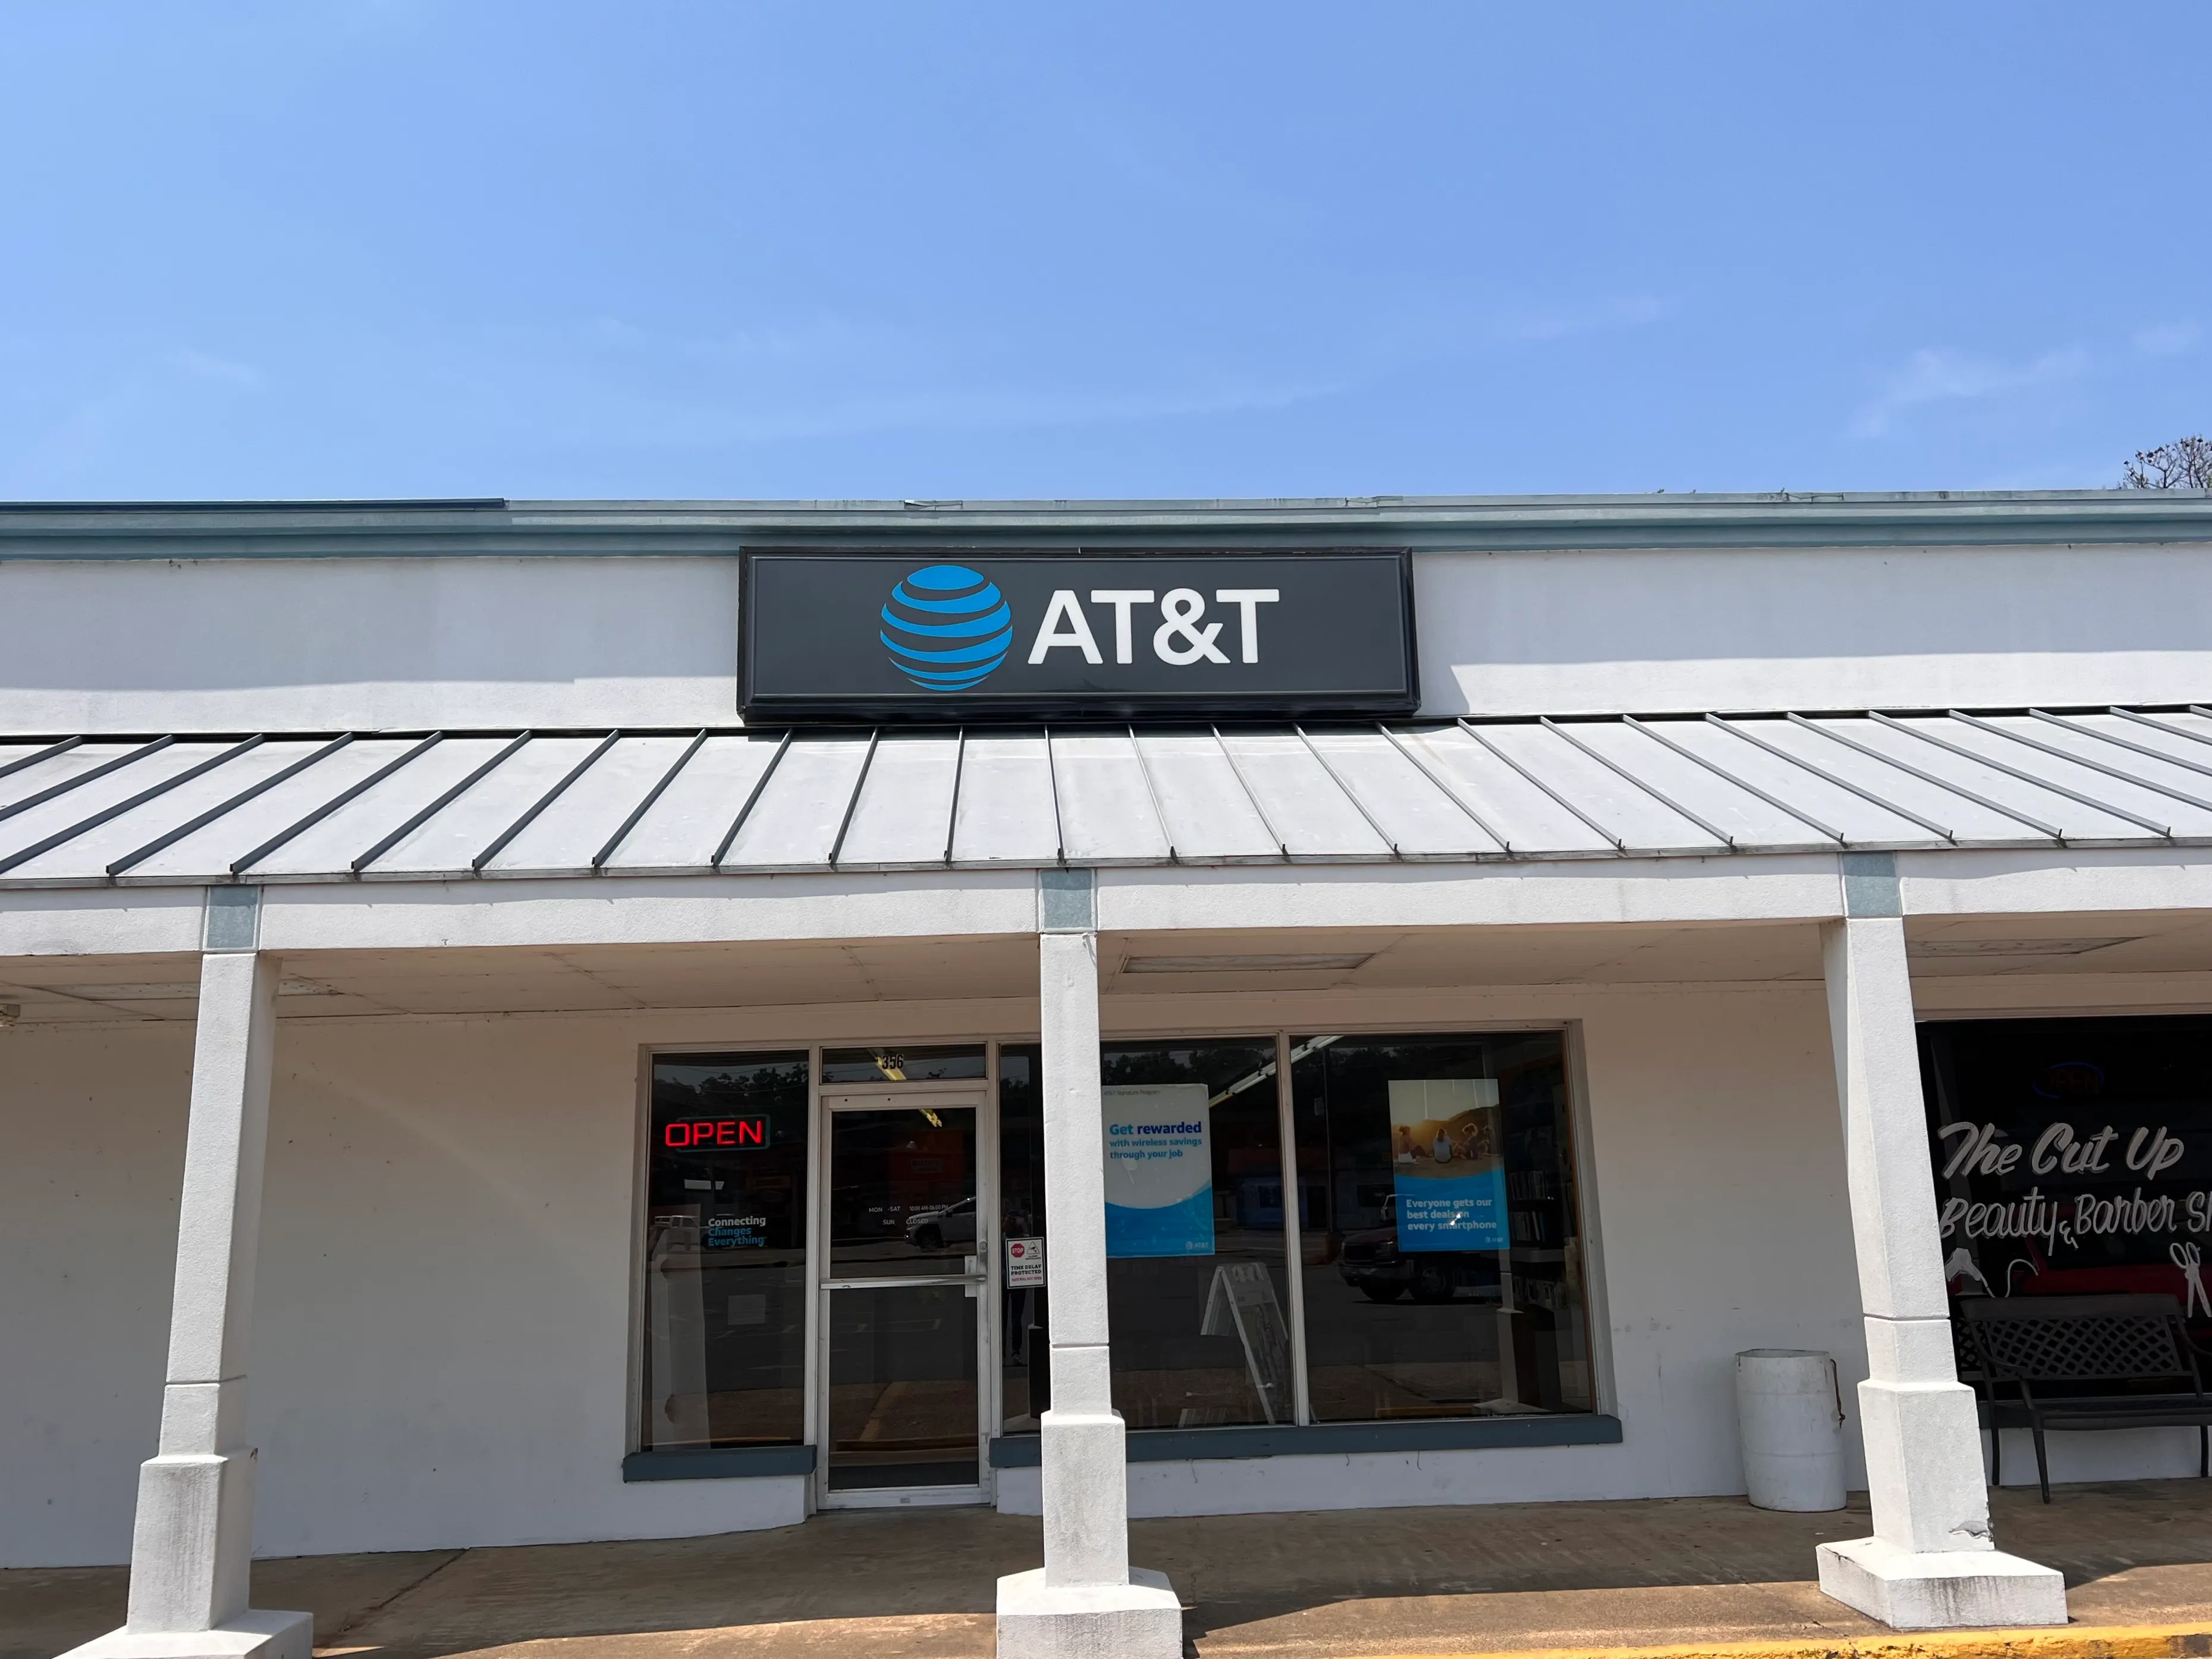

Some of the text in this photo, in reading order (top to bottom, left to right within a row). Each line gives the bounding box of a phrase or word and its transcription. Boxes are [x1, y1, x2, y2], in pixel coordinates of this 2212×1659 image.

[1028, 587, 1279, 666] AT&T
[882, 1054, 904, 1070] 356
[1110, 1121, 1202, 1135] Get rewarded
[665, 1120, 764, 1148] OPEN
[1110, 1137, 1202, 1147] with wireless savings
[1110, 1149, 1183, 1160] through your job
[1938, 1121, 2185, 1180] The Cut Up
[1406, 1199, 1451, 1209] Everyone
[1453, 1199, 1474, 1209] gets
[1407, 1209, 1428, 1219] best
[1430, 1209, 1456, 1218] deals
[708, 1216, 766, 1227] Connecting
[1407, 1220, 1497, 1232] every smartphone
[1939, 1186, 2058, 1256] Beauty
[2075, 1187, 2178, 1234] Barber
[708, 1226, 752, 1236] Changes
[708, 1236, 765, 1247] Everything
